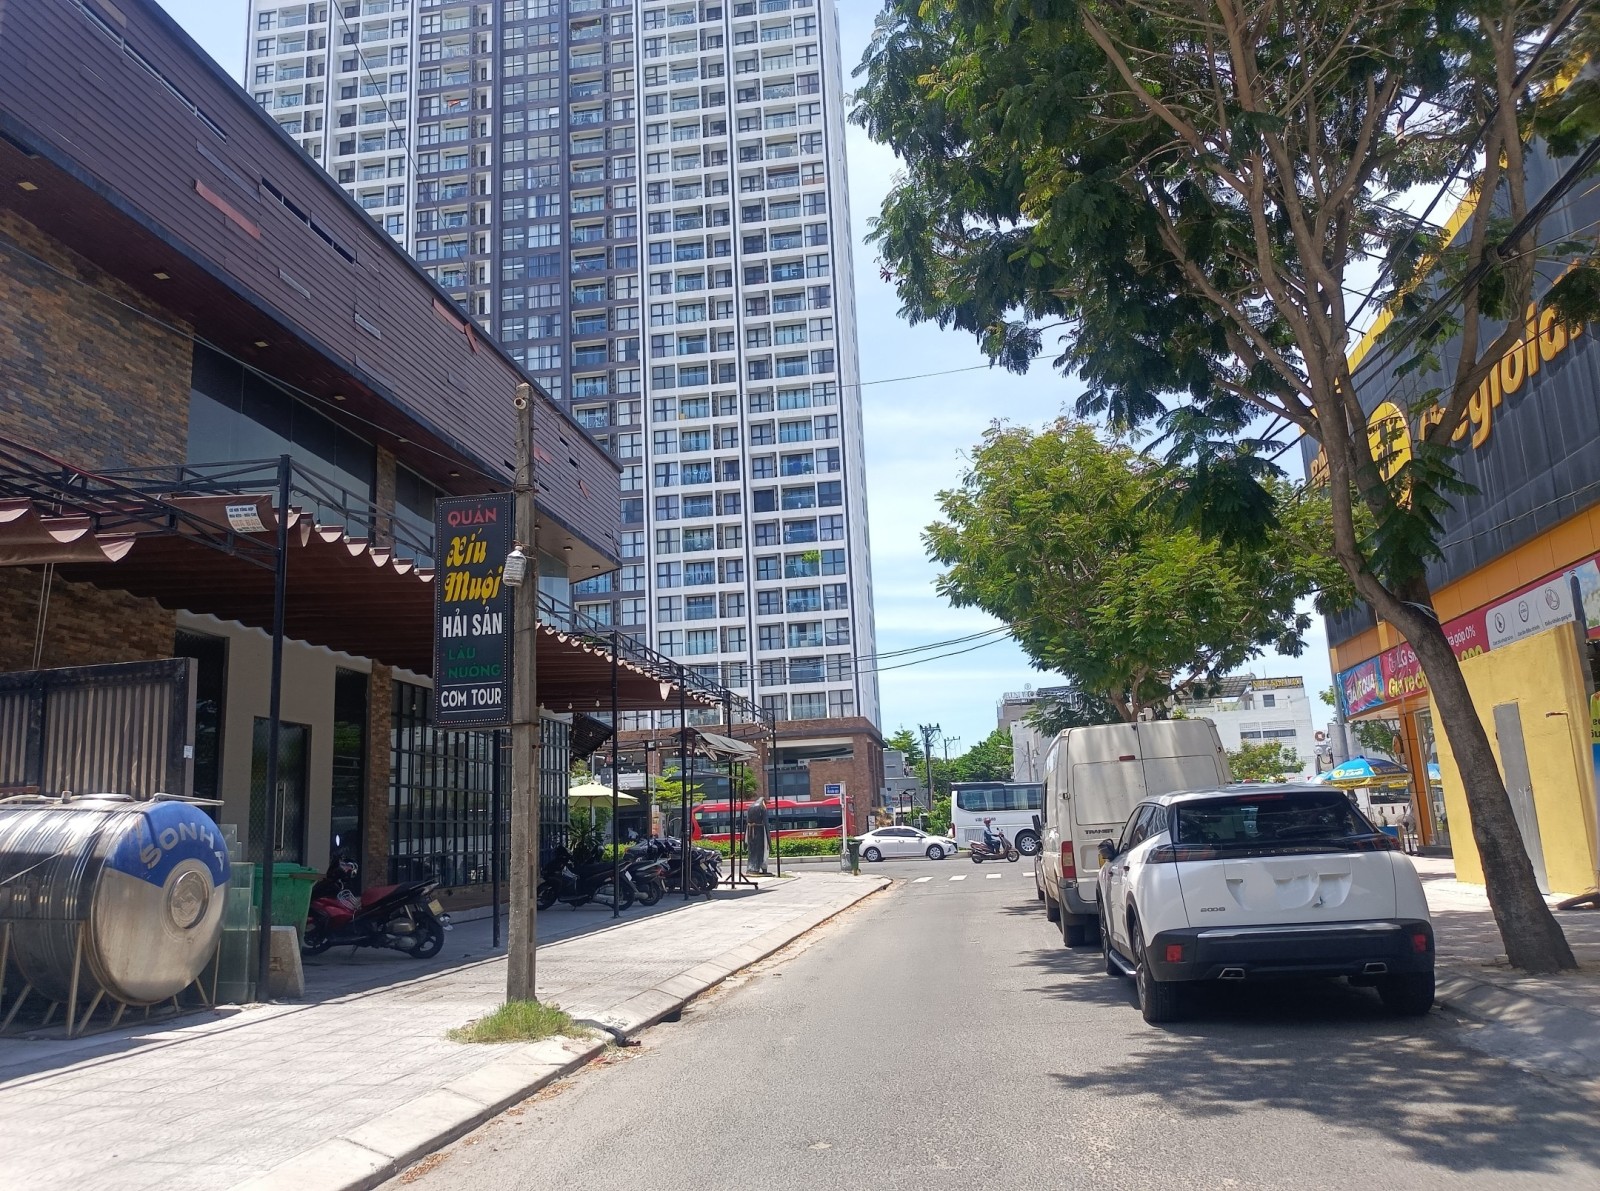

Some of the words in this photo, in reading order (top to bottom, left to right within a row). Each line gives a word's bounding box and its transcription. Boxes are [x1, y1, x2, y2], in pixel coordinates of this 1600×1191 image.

[447, 504, 497, 527] QUÁN
[444, 565, 504, 605] Muội
[442, 608, 467, 638] HẢI
[472, 606, 503, 636] SẢN
[441, 690, 467, 708] CƠM
[471, 687, 502, 706] TOUR
